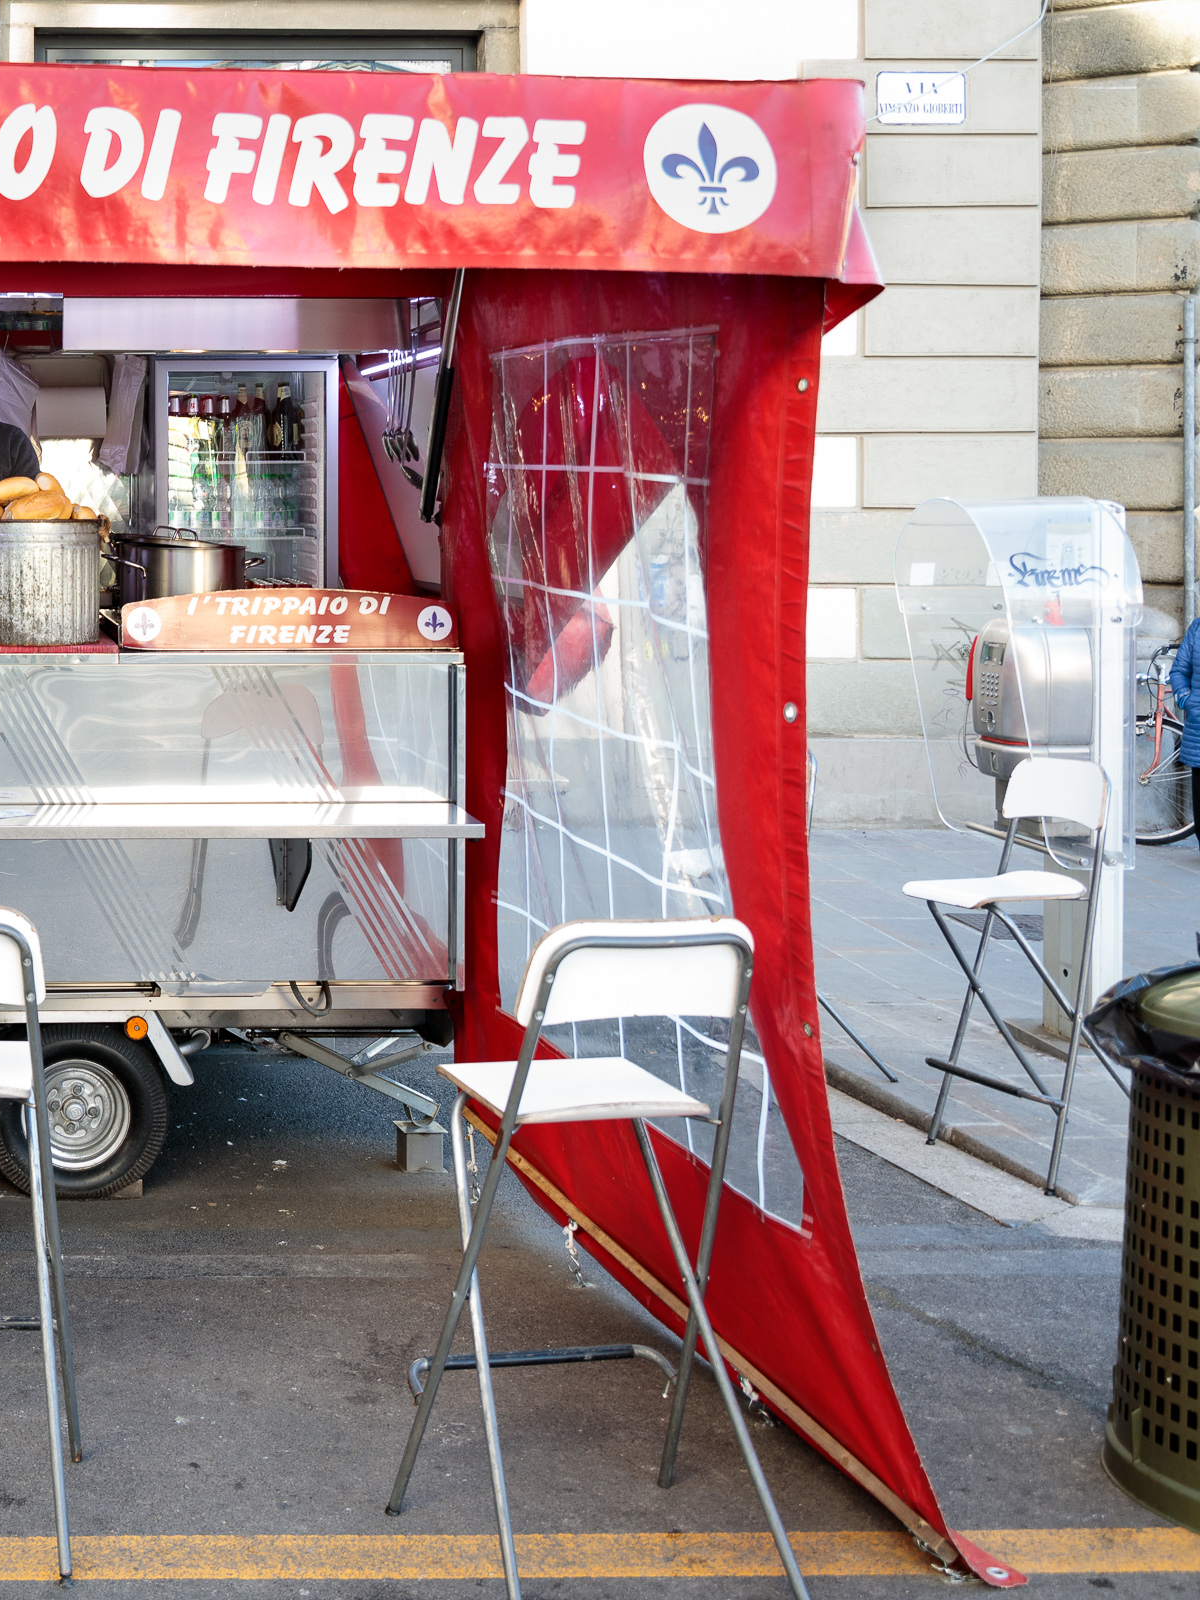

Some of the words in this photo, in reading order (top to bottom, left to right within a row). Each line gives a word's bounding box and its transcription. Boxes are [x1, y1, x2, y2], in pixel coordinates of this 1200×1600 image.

[905, 82, 939, 94] VIA
[923, 103, 962, 114] GIOBERTI
[81, 107, 181, 201] DI
[204, 114, 585, 214] FIRENZE
[214, 596, 349, 617] TRIPPAIO
[358, 596, 391, 615] DI
[229, 625, 351, 645] FIRENZE
